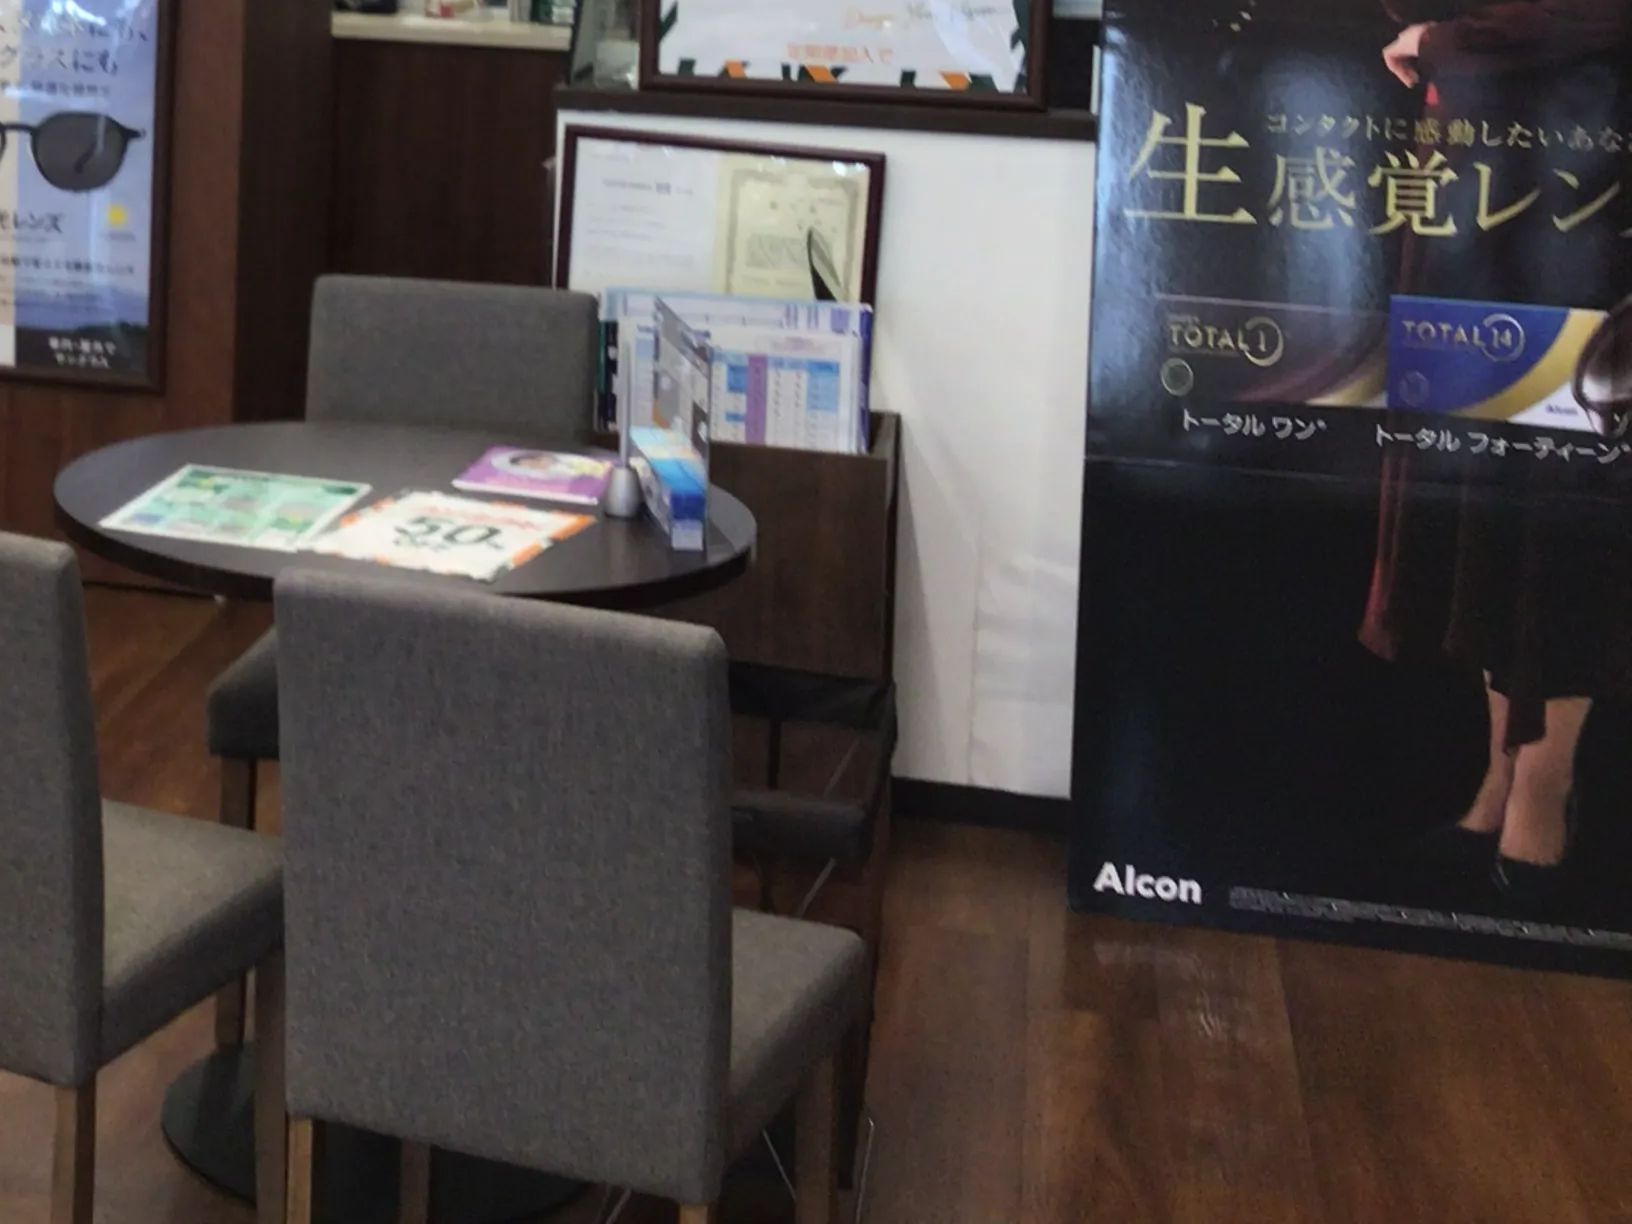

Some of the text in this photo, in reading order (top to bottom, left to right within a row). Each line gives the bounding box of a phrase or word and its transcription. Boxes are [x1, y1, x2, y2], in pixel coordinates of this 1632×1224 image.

[1123, 102, 1632, 237] 生感覚レン
[1094, 861, 1202, 904] Alcon
